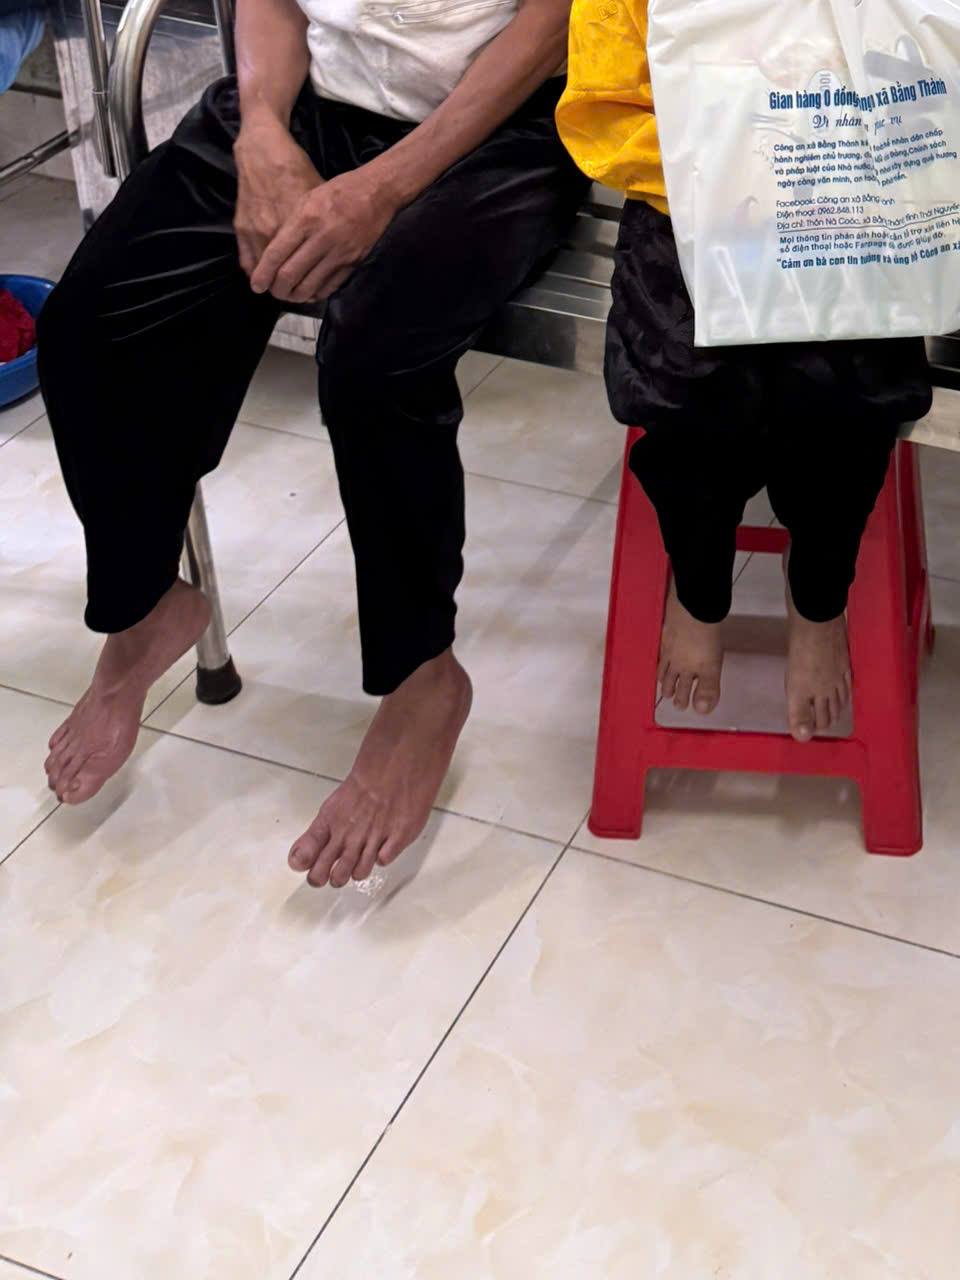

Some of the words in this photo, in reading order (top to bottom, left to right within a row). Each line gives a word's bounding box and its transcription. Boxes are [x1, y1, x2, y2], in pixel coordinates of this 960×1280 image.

[769, 91, 793, 110] Gian
[796, 89, 821, 109] hàng
[875, 87, 890, 107] xã
[890, 80, 917, 103] Bằng
[917, 78, 947, 97] Thành
[773, 143, 794, 152] Công
[795, 143, 806, 151] an
[838, 140, 859, 148] Thành
[774, 155, 793, 163] hành
[794, 153, 820, 164] nghiêm
[786, 167, 805, 176] pháp
[777, 179, 795, 188] ngày
[817, 196, 839, 205] Công
[780, 236, 794, 245] Mọi
[796, 234, 820, 243] thông
[792, 244, 810, 253] điện
[811, 242, 832, 251] thoại
[829, 257, 845, 265] con
[847, 255, 858, 265] tin
